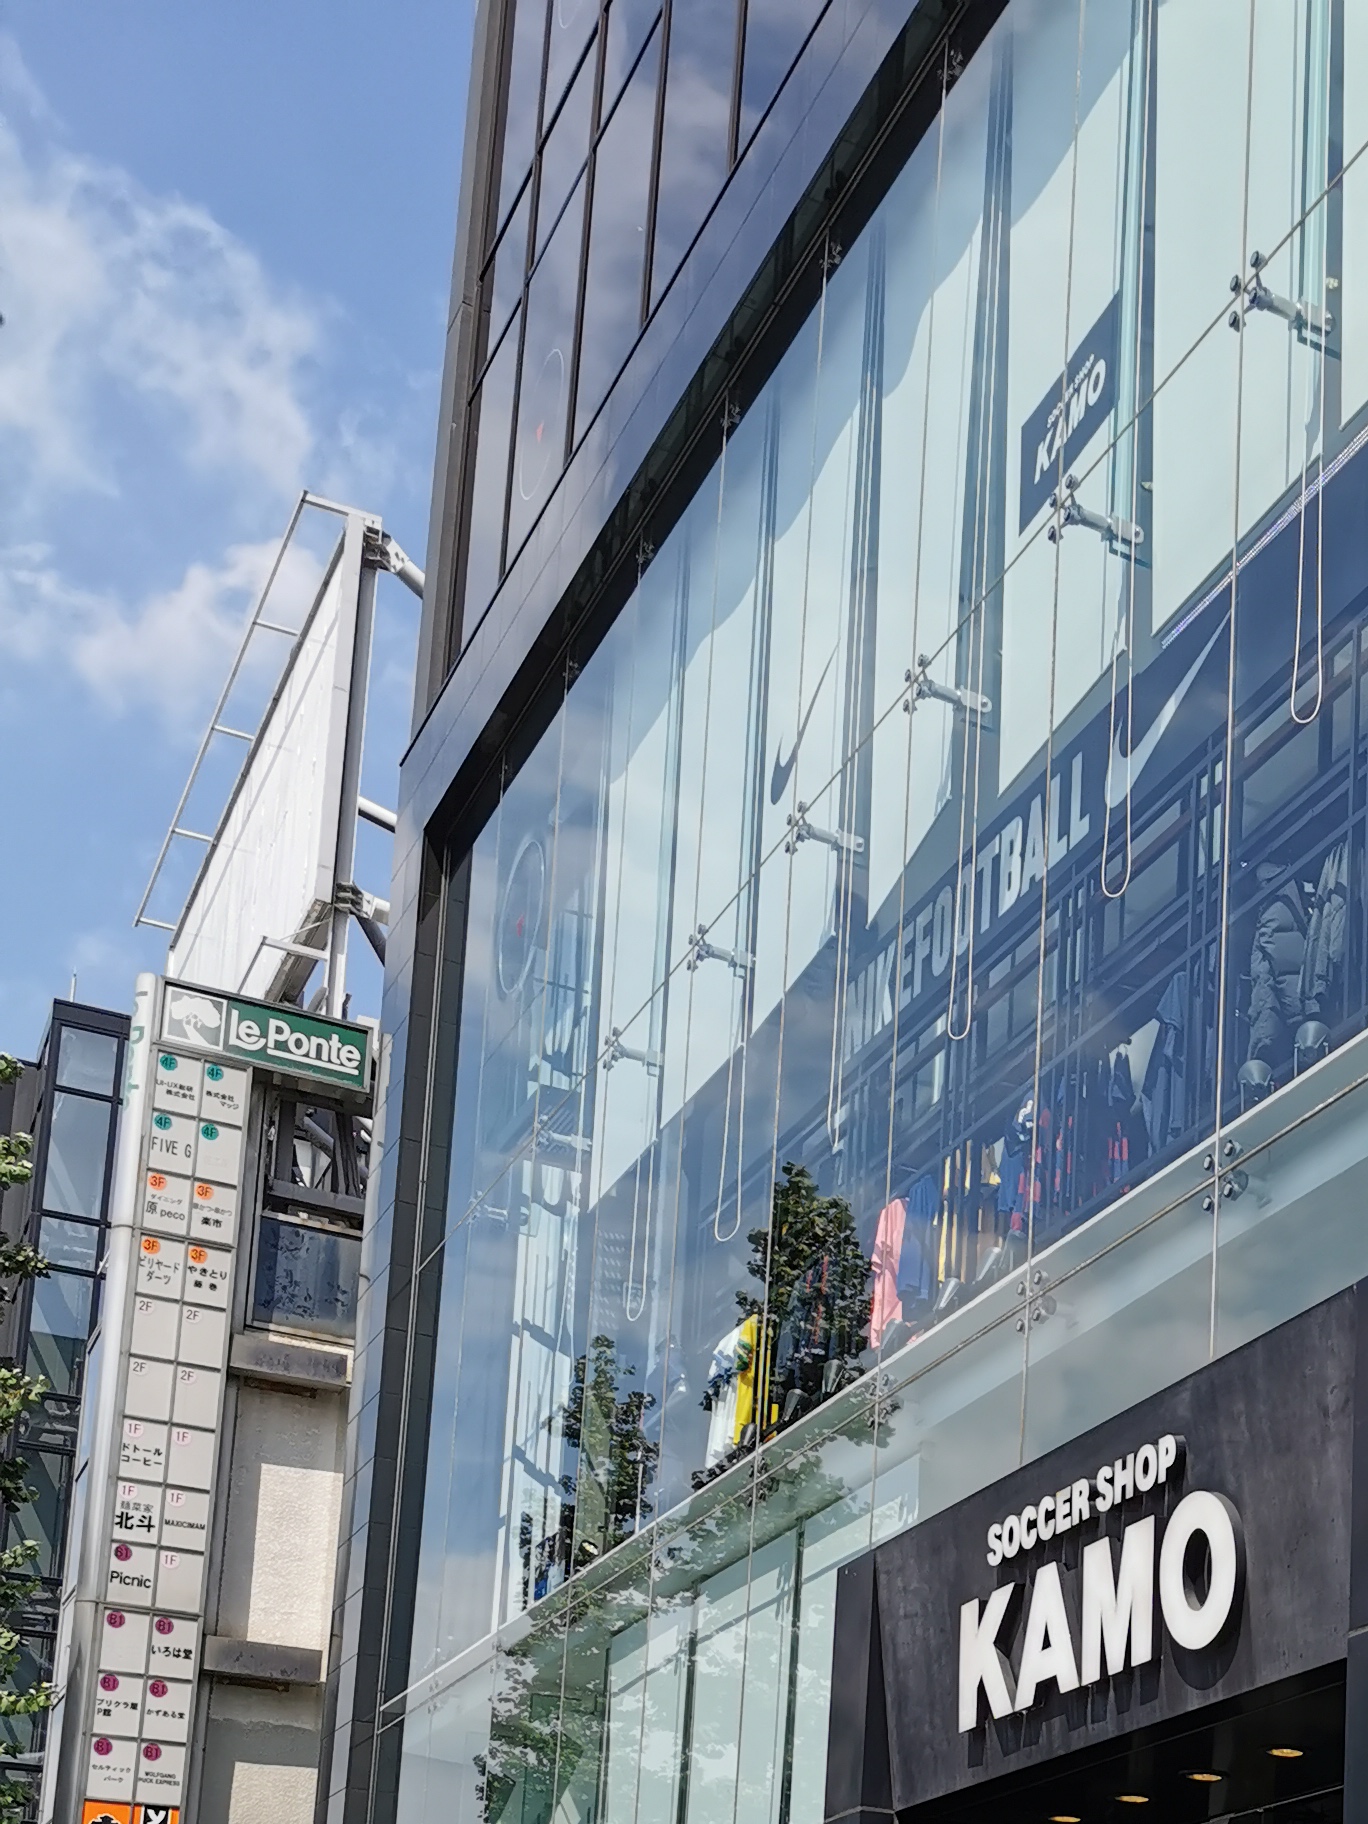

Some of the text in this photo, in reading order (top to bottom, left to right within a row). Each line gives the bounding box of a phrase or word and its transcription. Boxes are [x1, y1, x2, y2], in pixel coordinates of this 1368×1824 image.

[1034, 358, 1107, 485] KAMO
[161, 1055, 177, 1070] 4F
[208, 1065, 223, 1080] 4F
[165, 1088, 196, 1101] 株式会社
[205, 1090, 235, 1102] 株式会社
[155, 1115, 171, 1131] 4F
[203, 1126, 219, 1141] 4F
[151, 1136, 192, 1159] FIVE G
[150, 1175, 166, 1187] 3F
[197, 1185, 212, 1197] 3F
[145, 1201, 186, 1221] 原 peco
[143, 1239, 158, 1251] 3F
[189, 1248, 205, 1261] 3F
[146, 1271, 172, 1285] ダーツ
[188, 1265, 228, 1281] やきとり
[139, 1300, 153, 1312] 2F
[186, 1309, 200, 1321] 2F
[132, 1361, 147, 1373] 2F
[180, 1370, 195, 1382] 2F
[128, 1423, 142, 1435] 1F
[176, 1431, 190, 1443] 1F
[122, 1443, 163, 1457] ドトール
[121, 1454, 163, 1467] コーヒー
[122, 1485, 136, 1496] 1F
[171, 1492, 184, 1504] 1F
[986, 1434, 1177, 1566] SOCCER SHOP
[114, 1511, 156, 1534] 北斗
[164, 1554, 178, 1566] 1F
[109, 1570, 152, 1589] Picnic
[958, 1490, 1237, 1734] KAMO
[151, 1644, 193, 1661] いろは堂
